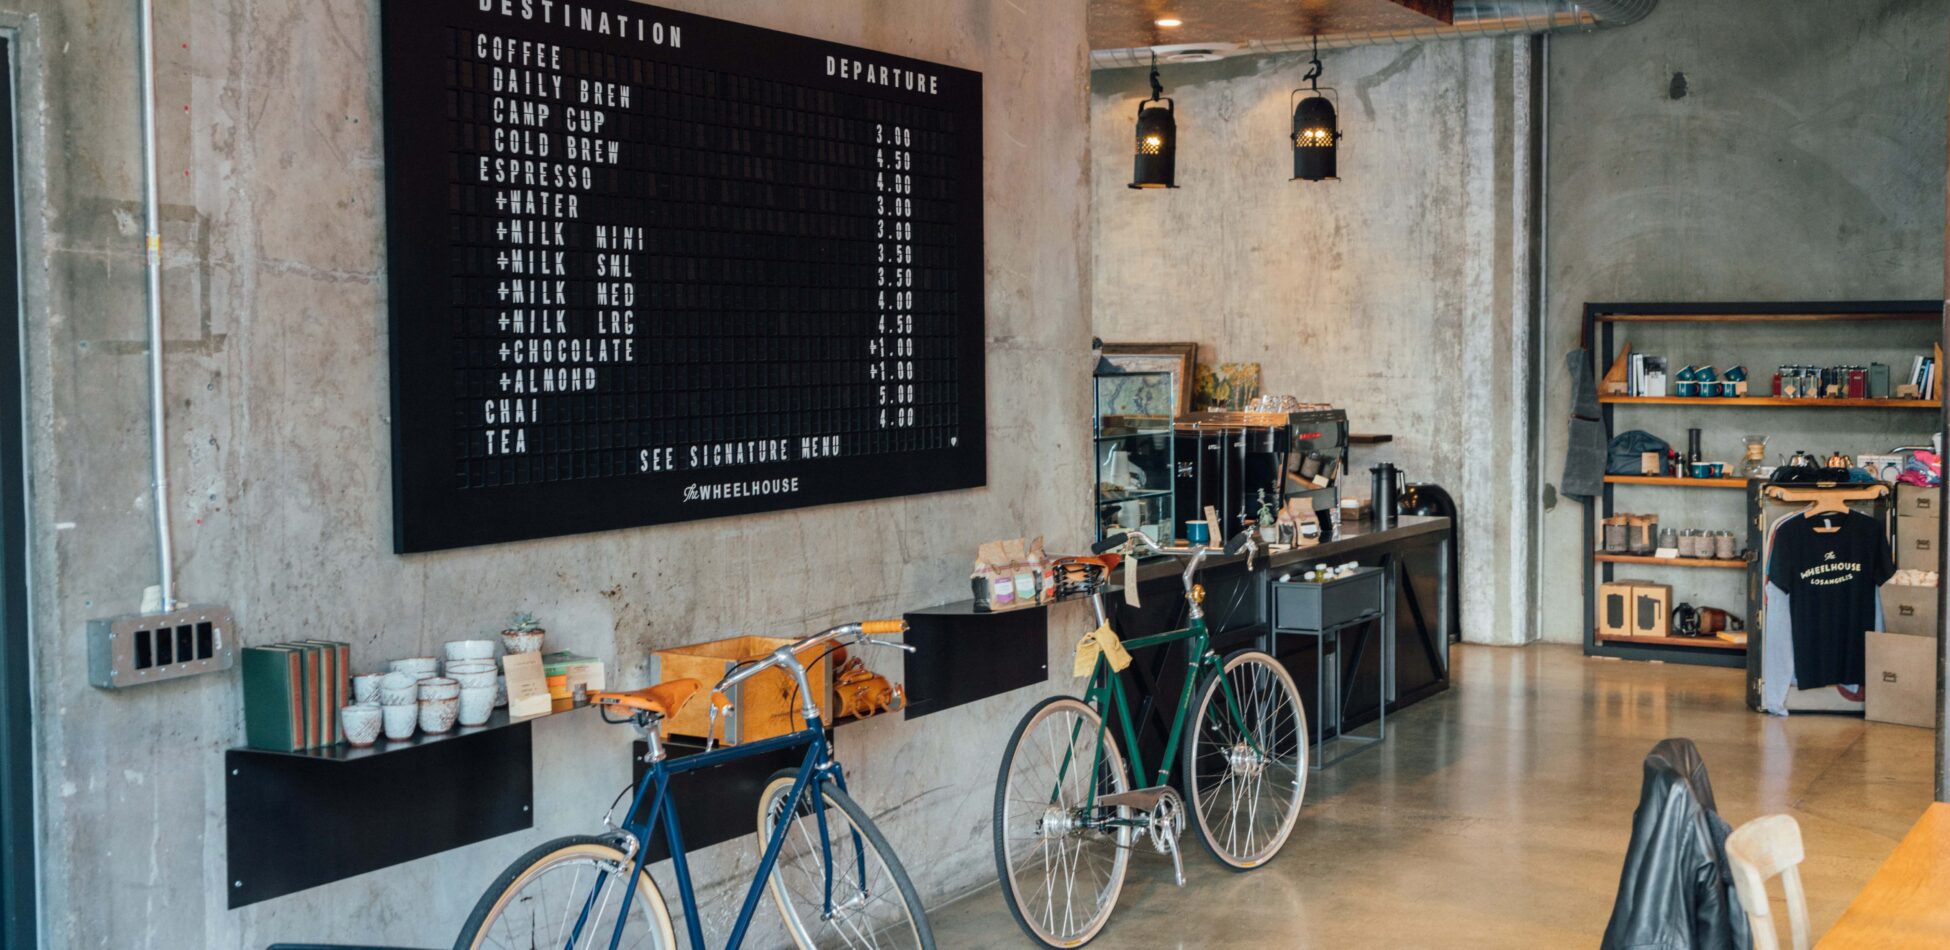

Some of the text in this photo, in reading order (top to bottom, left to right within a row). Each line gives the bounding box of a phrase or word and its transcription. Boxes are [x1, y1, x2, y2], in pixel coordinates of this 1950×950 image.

[477, 33, 560, 70] COFFEE
[493, 66, 630, 109] DAILY BREW
[826, 55, 939, 95] DEPARTURE
[493, 96, 605, 134] CAMP CUP
[494, 127, 619, 165] COLD BREW
[876, 123, 911, 148] 3.00
[876, 148, 911, 171] 4.50
[479, 156, 592, 190] ESPRESSO
[876, 171, 911, 195] 4.00
[496, 189, 578, 219] +WATER
[877, 195, 912, 217] 3.00
[496, 219, 643, 251] +MILK MINI
[877, 219, 912, 241] 3.00
[496, 248, 632, 279] +MILK SML
[878, 243, 912, 264] 3.50
[877, 266, 912, 288] 3.50
[497, 278, 634, 307] +MILK MED
[878, 290, 912, 311] 4.00
[498, 309, 635, 335] +MILK LRG
[878, 314, 913, 334] 4.50
[498, 338, 634, 364] +CHOCOLATE
[869, 337, 913, 358] +1.00
[499, 367, 596, 394] +ALMOND
[869, 360, 914, 381] +1.00
[879, 384, 914, 406] 5.00
[484, 398, 537, 425] CHAI
[879, 407, 914, 429] 4.00
[485, 428, 527, 455] TEA
[640, 434, 841, 472] SEE SIGNATURE MENU
[683, 477, 799, 503] The WHEELHOUSE
[1800, 562, 1862, 579] WHEELHOUSE
